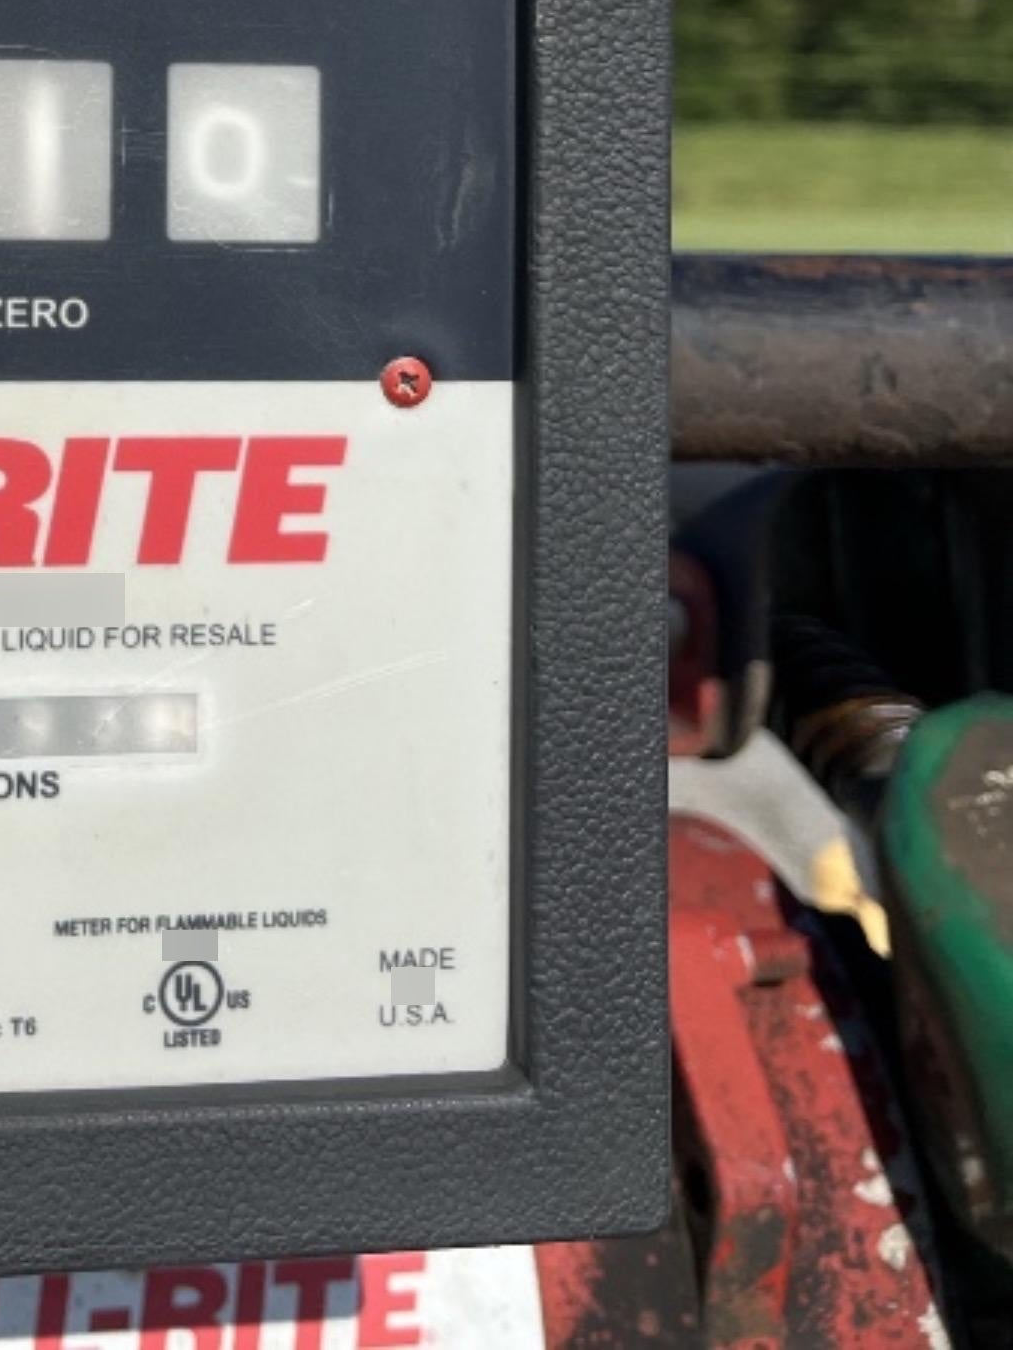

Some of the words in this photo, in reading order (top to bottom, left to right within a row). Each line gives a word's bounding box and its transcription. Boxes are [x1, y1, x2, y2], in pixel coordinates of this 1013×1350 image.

[1, 626, 96, 651] LIQUID
[103, 625, 162, 649] FOR
[169, 622, 278, 647] RESALE
[52, 916, 112, 938] METER
[116, 915, 151, 934] FOR
[155, 910, 259, 933] FLAMMABLE
[262, 907, 328, 929] LIQUIDS
[378, 946, 456, 973] MADE
[226, 988, 252, 1010] US
[10, 1015, 38, 1037] T6
[162, 1029, 222, 1049] LISTED
